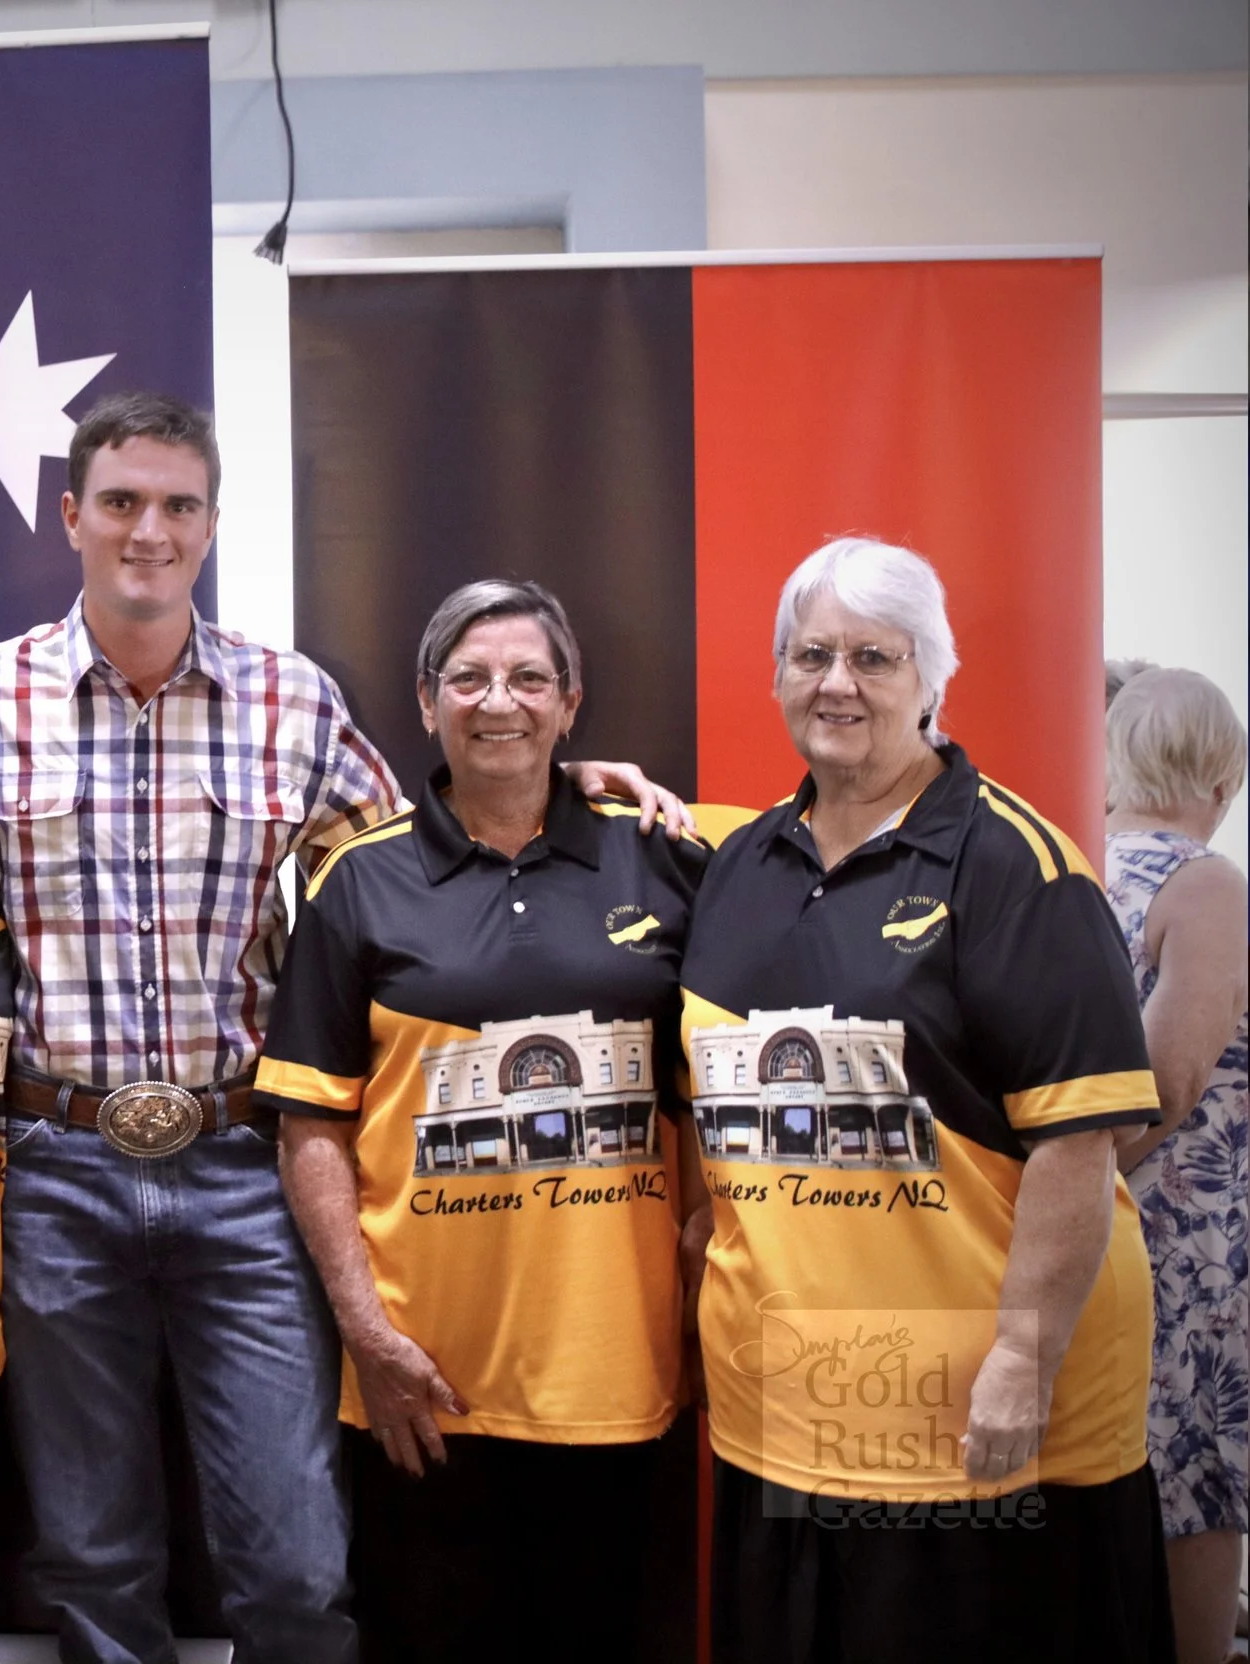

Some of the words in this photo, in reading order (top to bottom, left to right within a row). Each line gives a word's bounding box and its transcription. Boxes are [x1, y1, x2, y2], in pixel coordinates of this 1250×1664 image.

[410, 1189, 522, 1216] Charters
[533, 1177, 631, 1209] Towers
[631, 1170, 667, 1201] NQ
[778, 1174, 882, 1208] Towers
[886, 1179, 948, 1212] NQ
